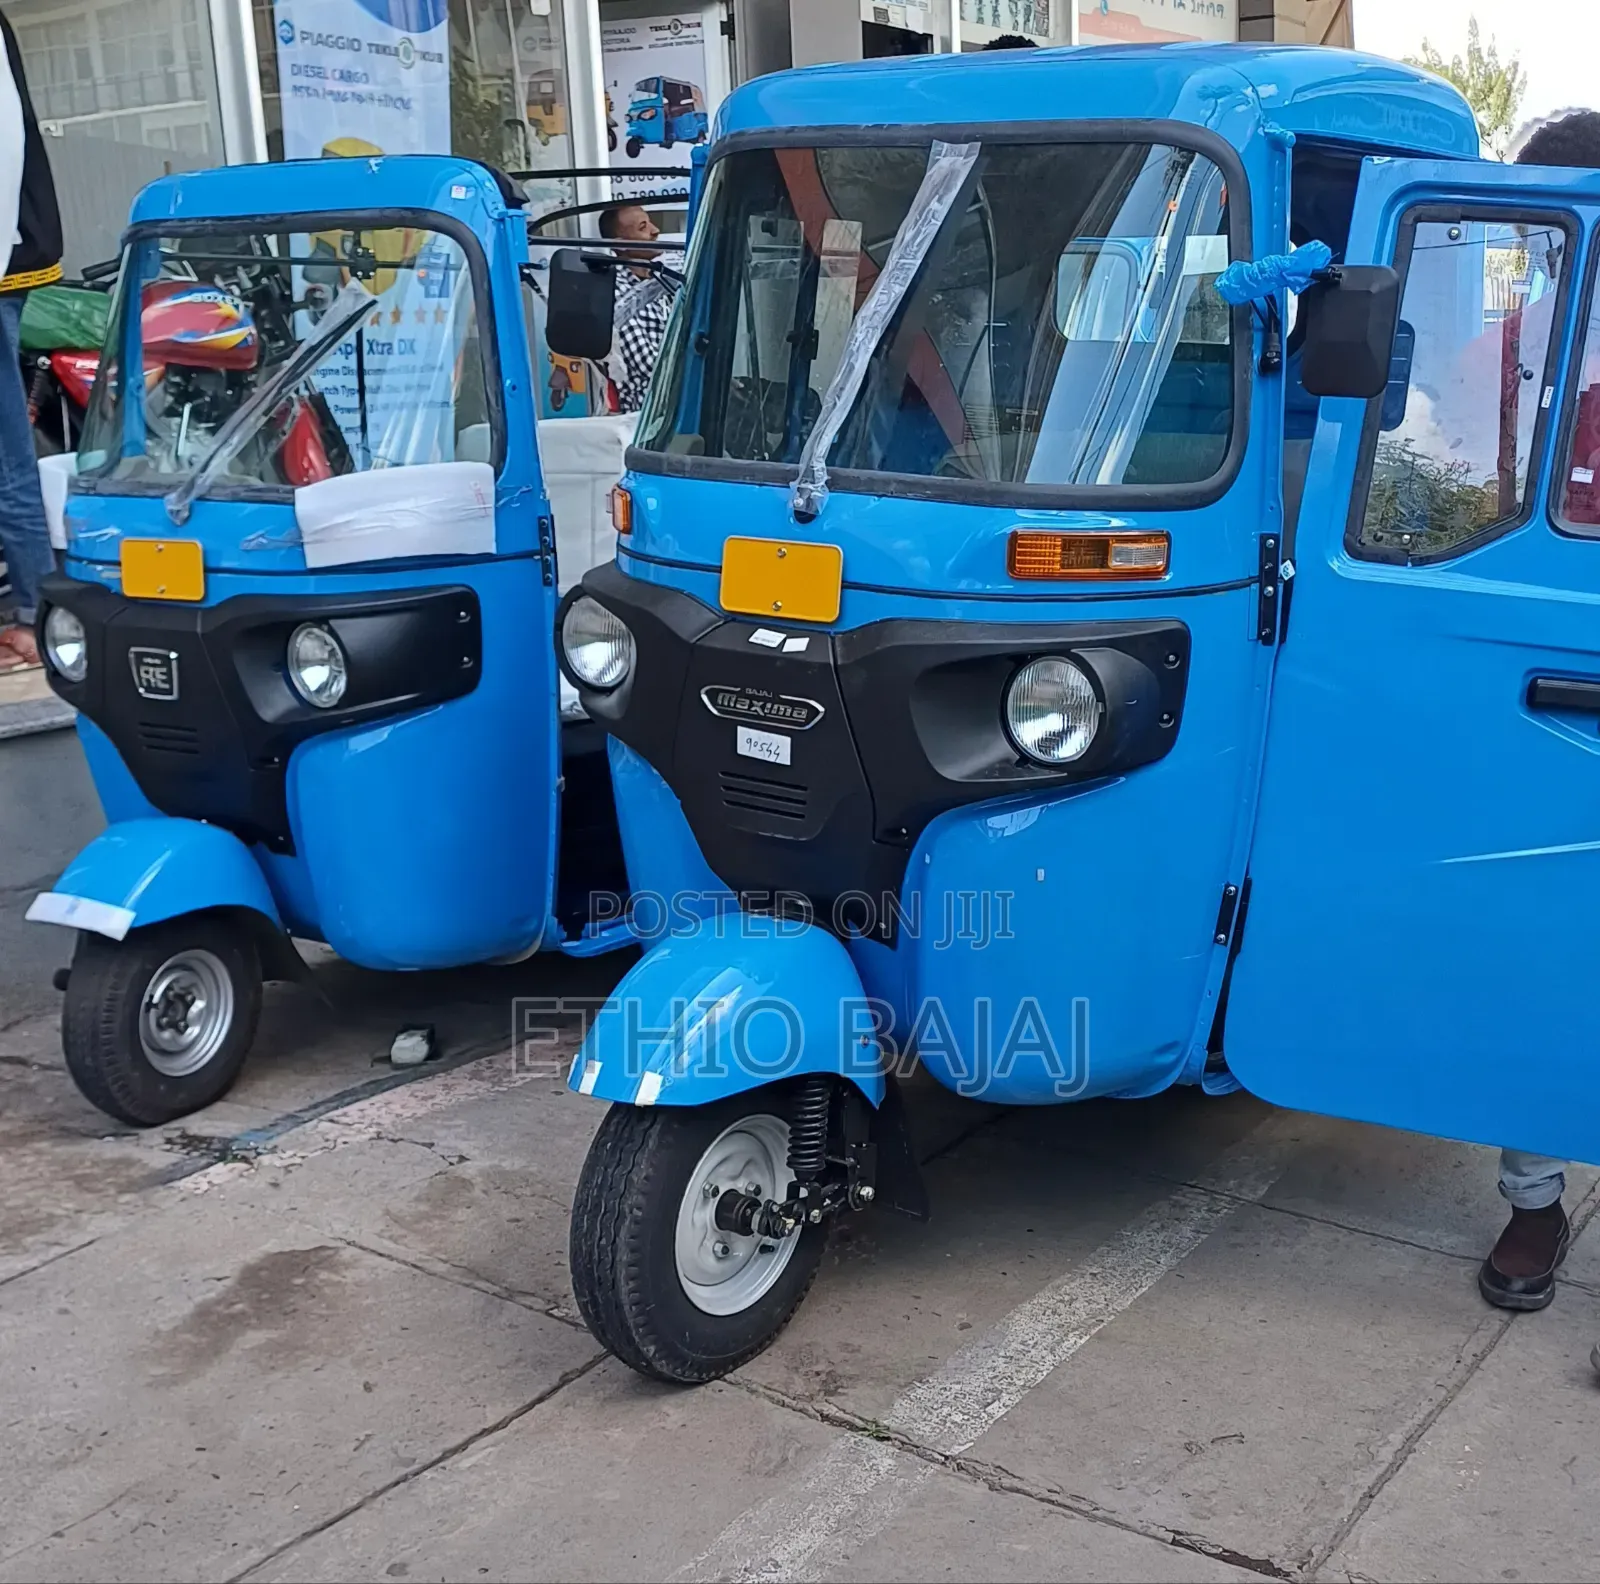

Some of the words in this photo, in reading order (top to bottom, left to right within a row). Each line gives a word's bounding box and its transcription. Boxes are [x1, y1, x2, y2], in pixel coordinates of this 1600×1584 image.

[300, 30, 362, 52] PIAGGIO
[290, 63, 329, 80] DIESEL
[331, 68, 370, 84] CARGO
[366, 338, 394, 356] Xtra
[398, 338, 416, 356] DX
[139, 665, 170, 689] RE
[745, 687, 773, 698] BAJAJ
[745, 737, 781, 762] 90544
